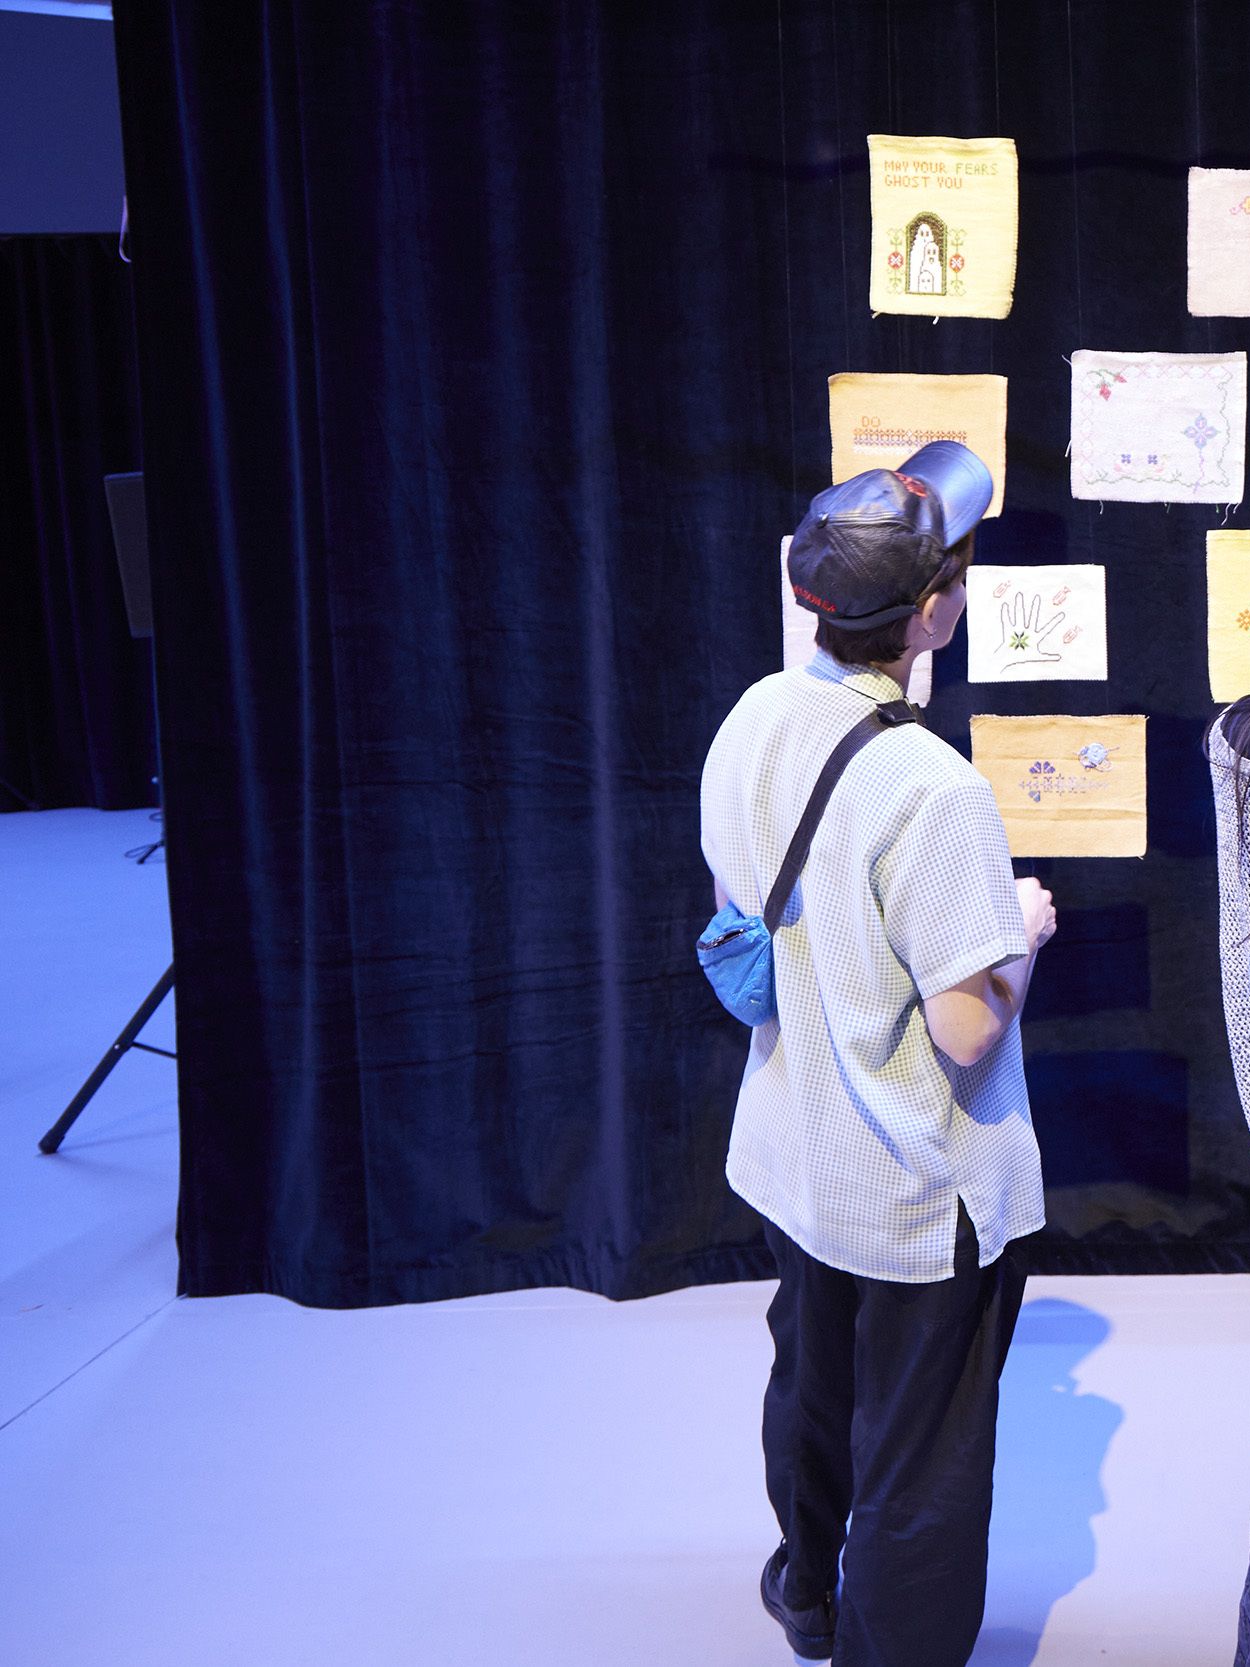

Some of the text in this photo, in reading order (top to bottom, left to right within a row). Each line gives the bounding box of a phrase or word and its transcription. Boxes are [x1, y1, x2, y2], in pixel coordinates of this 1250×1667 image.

[884, 160, 999, 176] MAY YOUR FEARS
[884, 174, 963, 190] GHOST YOU
